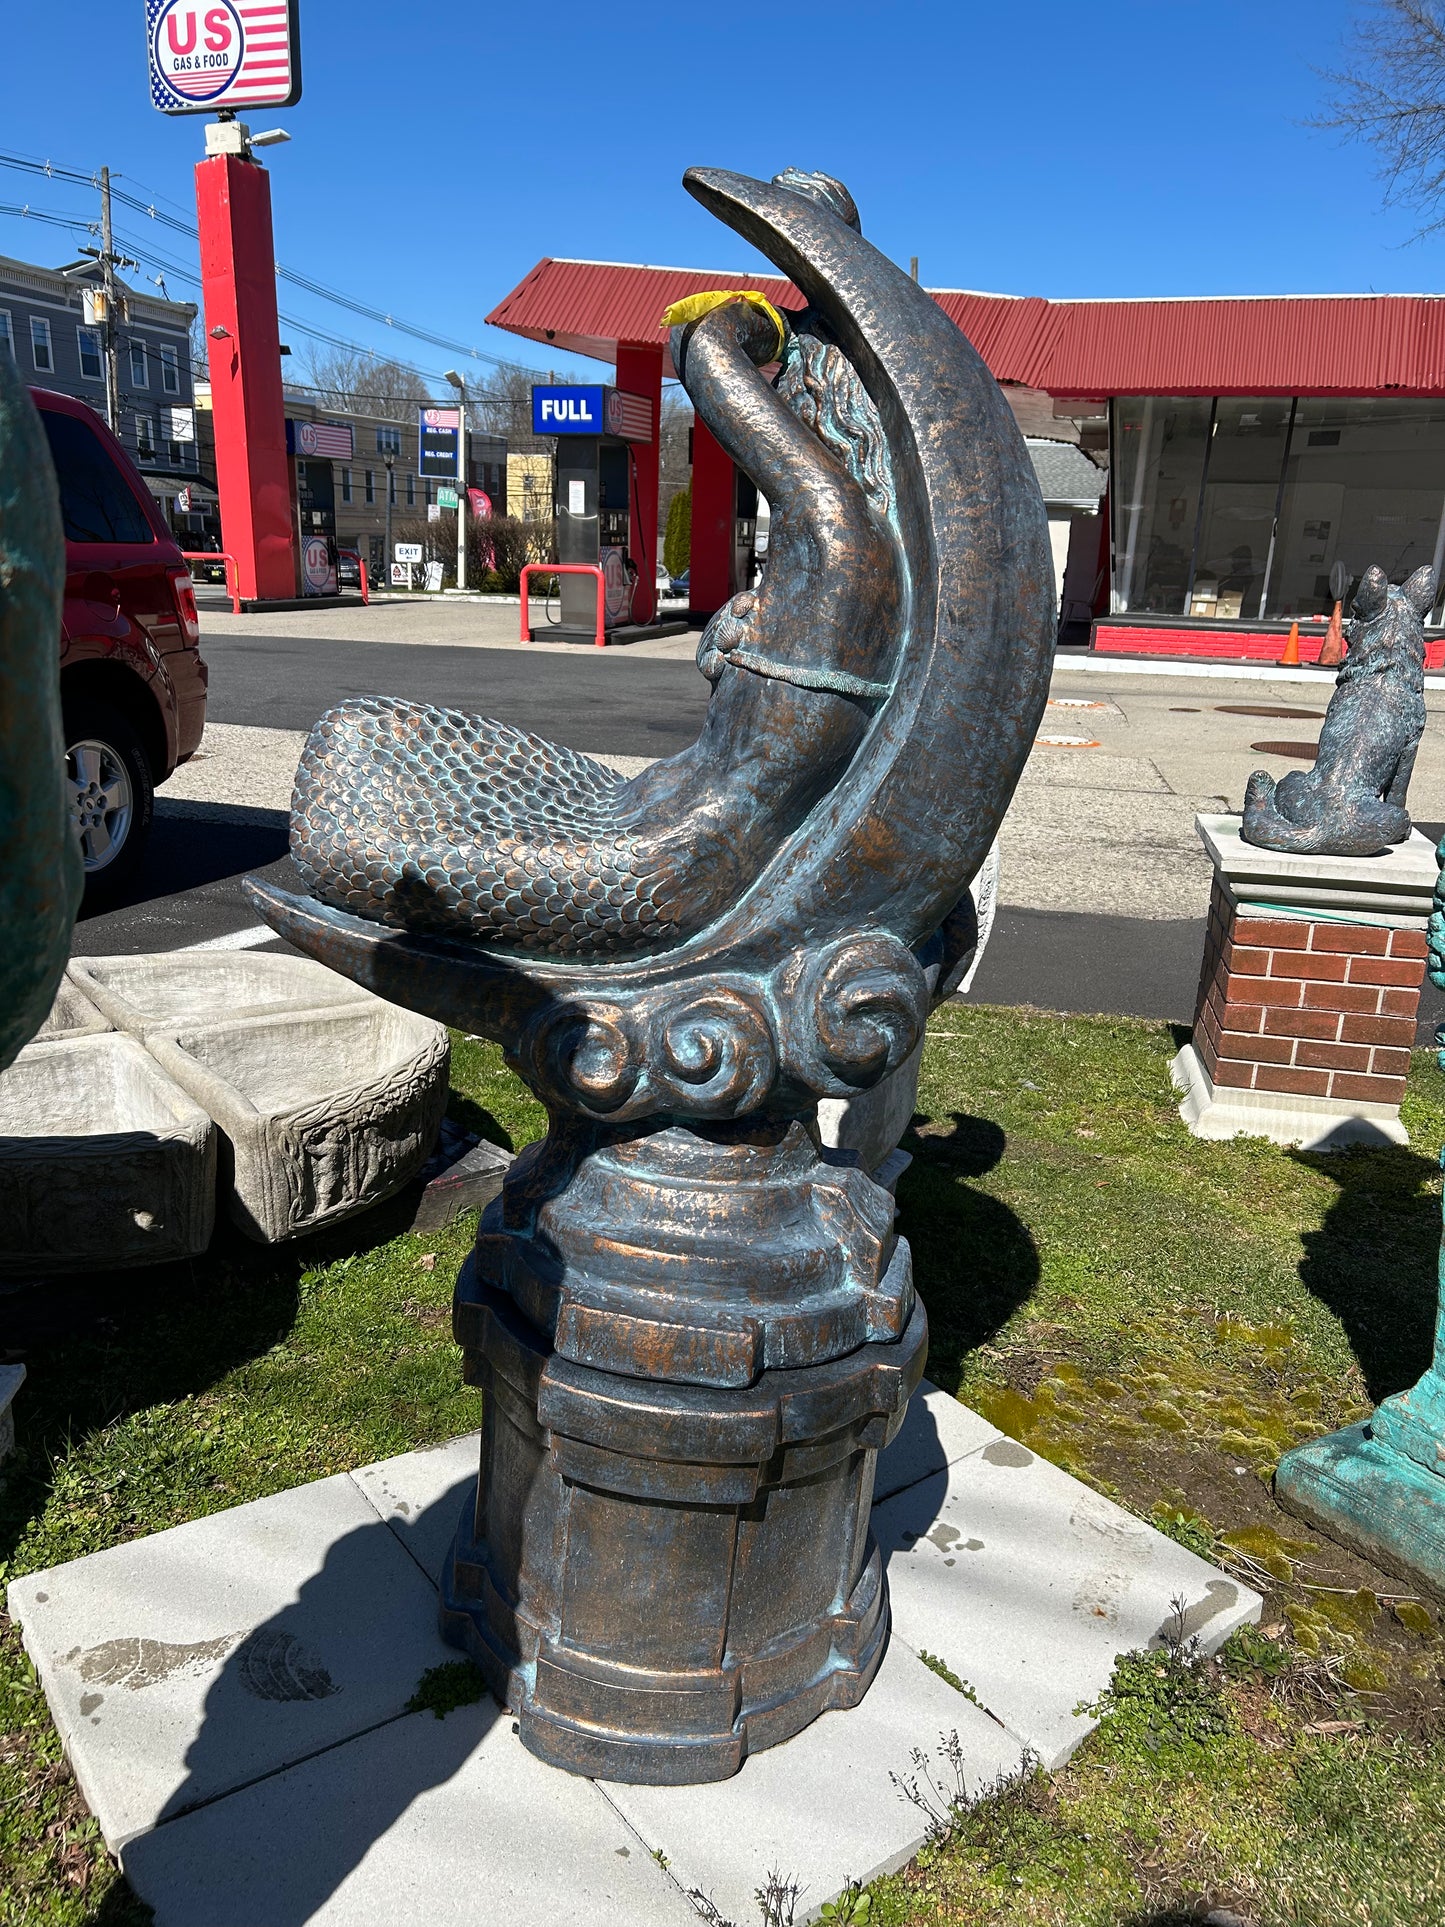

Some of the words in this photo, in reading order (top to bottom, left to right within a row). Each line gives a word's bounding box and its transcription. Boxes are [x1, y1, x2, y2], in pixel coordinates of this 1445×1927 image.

[167, 8, 232, 55] US
[173, 57, 192, 71] GAS
[194, 55, 201, 69] &
[203, 53, 229, 67] FOOD
[541, 399, 593, 420] FULL
[610, 398, 621, 416] US
[302, 429, 315, 442] US
[439, 489, 458, 502] ATM
[307, 549, 328, 568] US
[398, 547, 419, 556] EXIT
